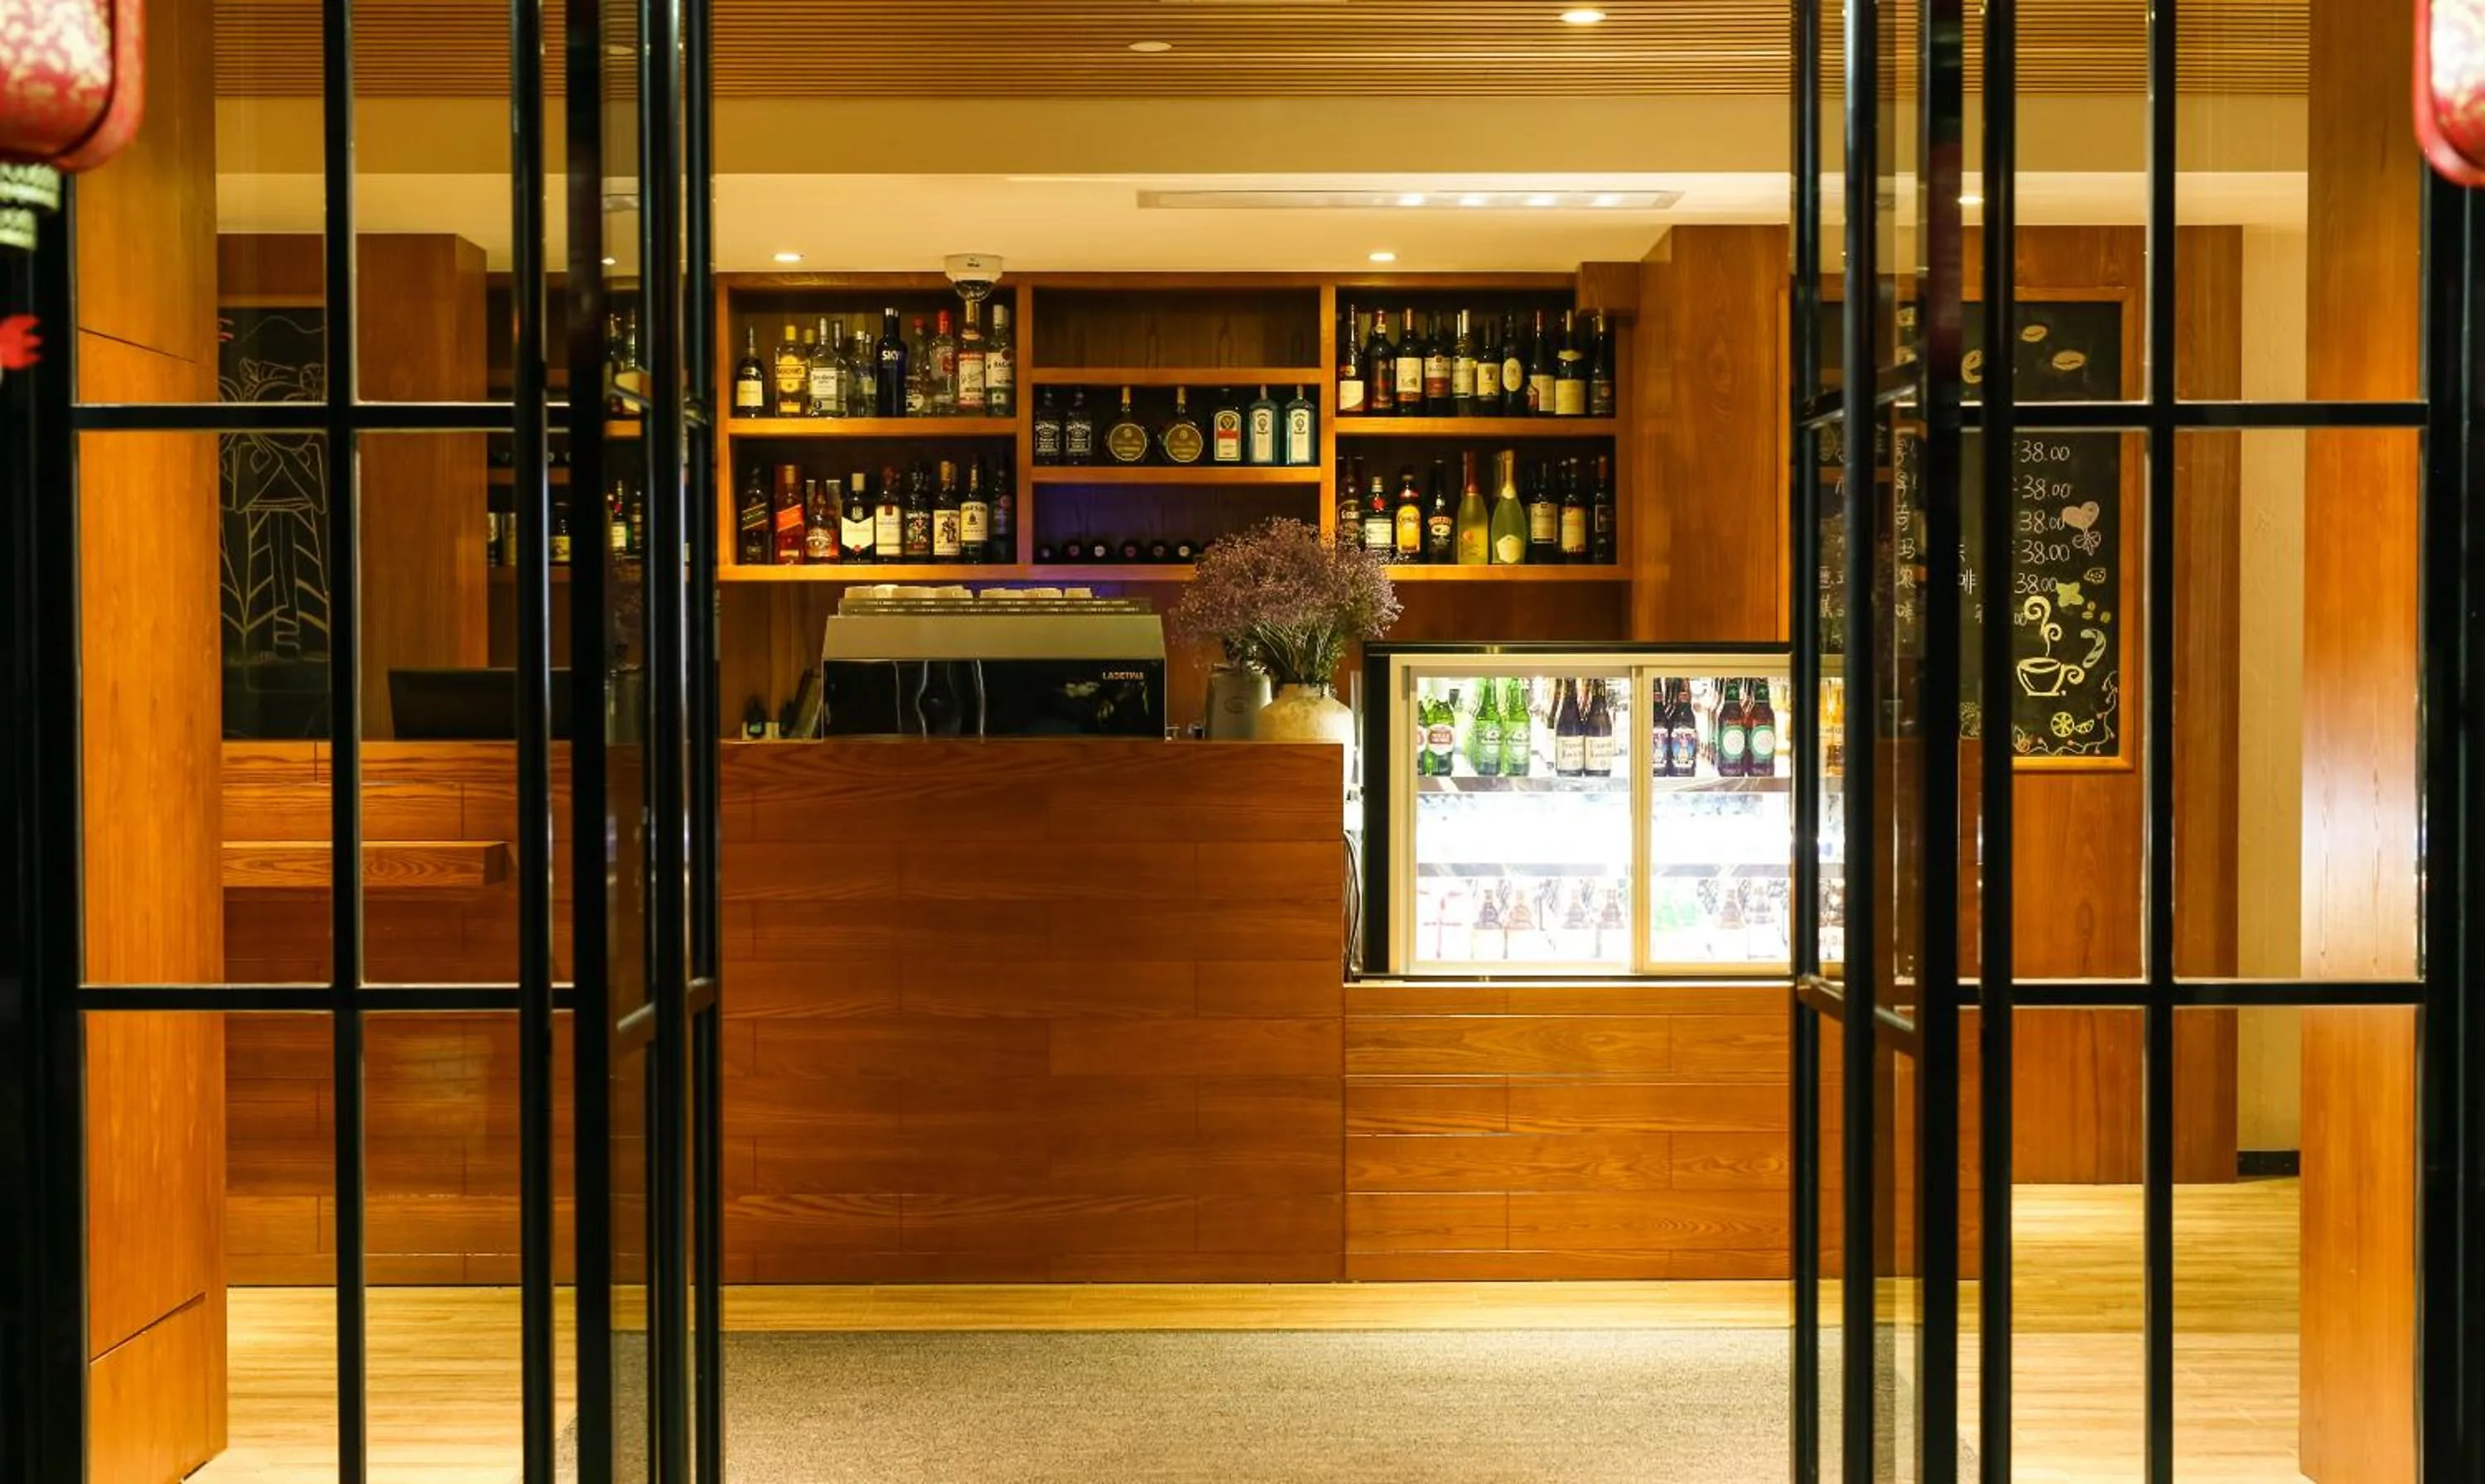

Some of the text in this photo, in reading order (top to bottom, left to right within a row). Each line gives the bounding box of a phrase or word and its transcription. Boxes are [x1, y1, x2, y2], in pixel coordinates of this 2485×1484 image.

[2020, 440, 2070, 463] 38.00
[2021, 475, 2071, 500] 38.00
[2019, 539, 2070, 564] 38.00
[2014, 572, 2058, 595] 38.00
